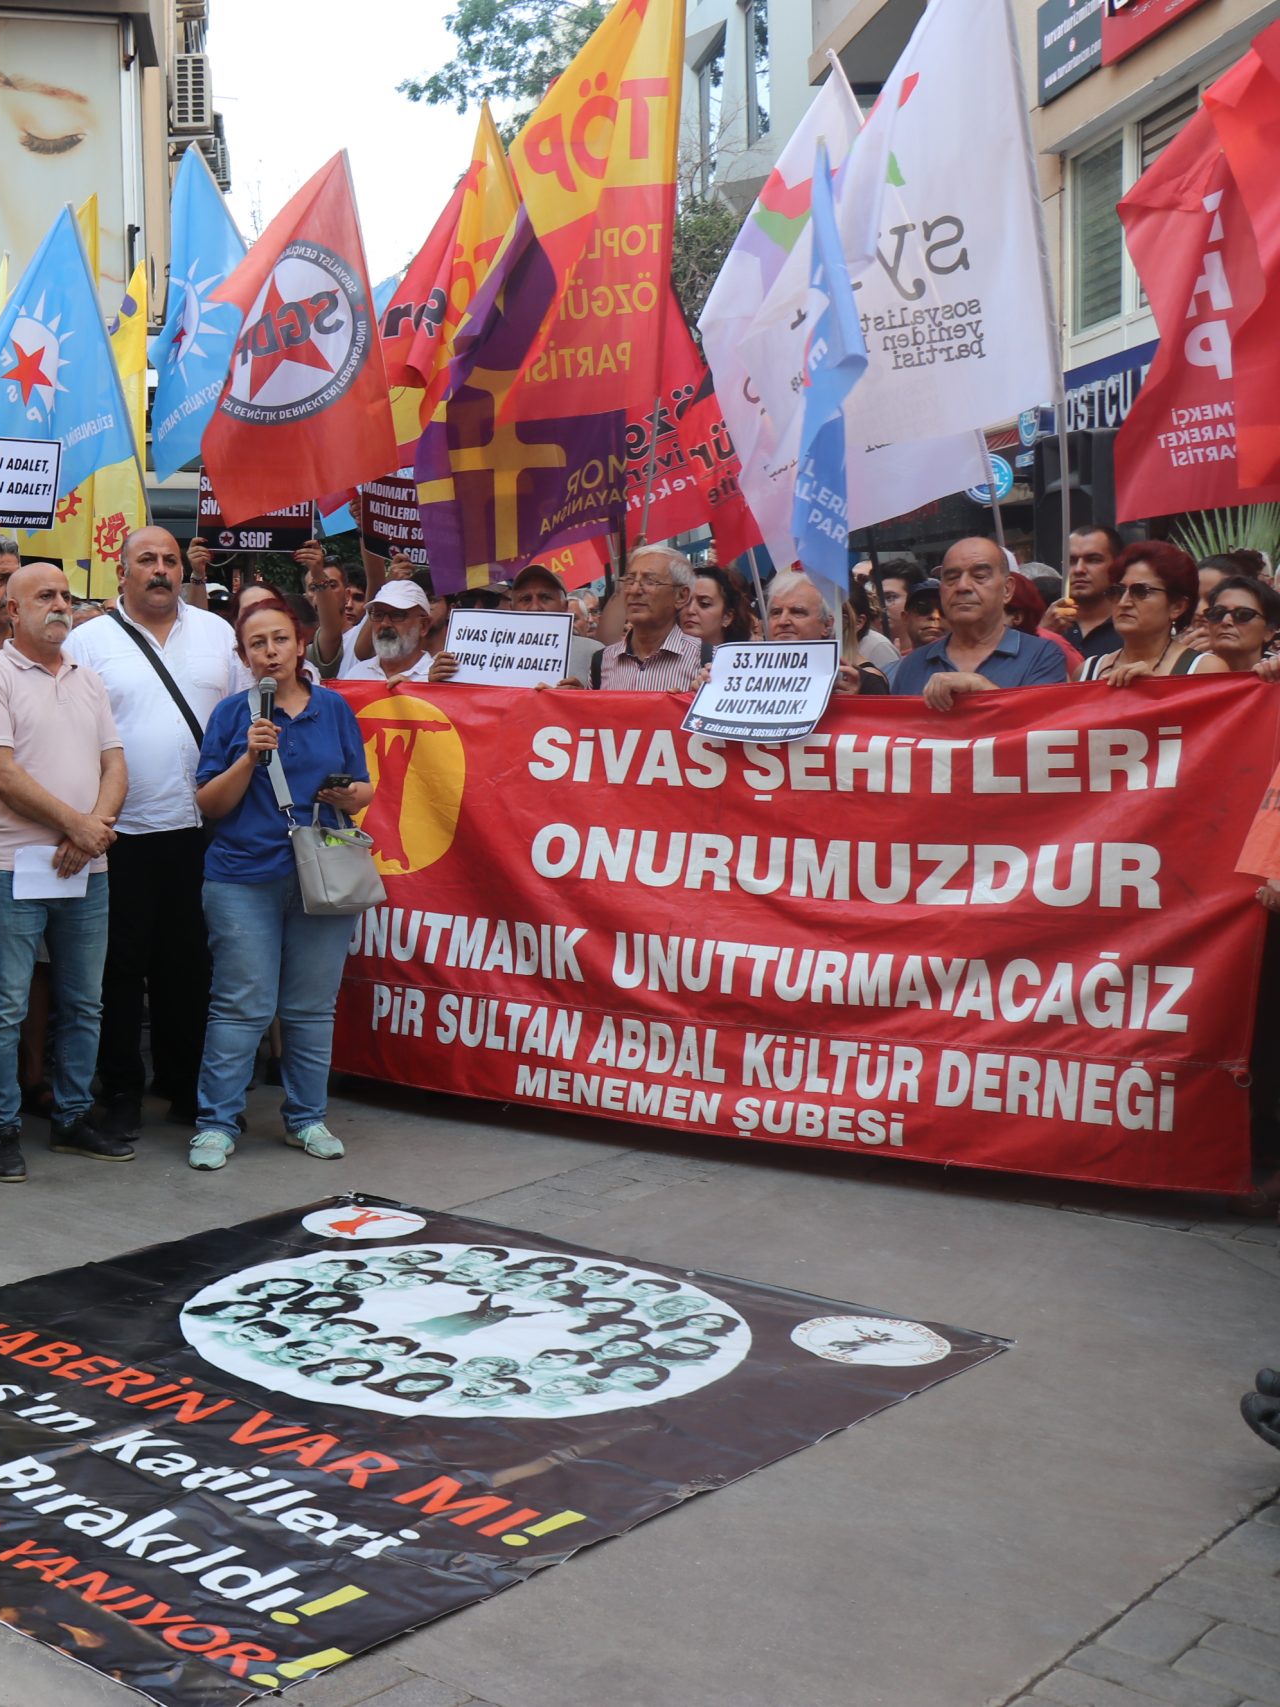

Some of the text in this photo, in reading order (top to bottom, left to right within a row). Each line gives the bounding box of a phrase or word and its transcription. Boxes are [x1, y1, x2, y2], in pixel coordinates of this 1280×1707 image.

[6, 457, 50, 475] ADALET,
[6, 482, 52, 497] ADALET!
[239, 532, 272, 548] SGDF
[455, 626, 560, 649] SİVAS İÇİN ADALET,
[489, 653, 515, 673] İÇİN
[516, 656, 563, 673] ADALET!
[723, 676, 812, 693] 33 CANIMIZI
[714, 697, 807, 716] UNUTMADIK!
[531, 823, 1162, 909] ONURUMUZDUR
[612, 931, 1195, 1034] UNUTTURMAYACAĞIZ
[436, 993, 582, 1061] SULTAN
[588, 1015, 726, 1083] ABDAL
[742, 1032, 924, 1103] KÜLTÜR
[515, 1064, 722, 1125] MENEMEN
[229, 1411, 400, 1489] VAR
[89, 1430, 421, 1559] Katilleri
